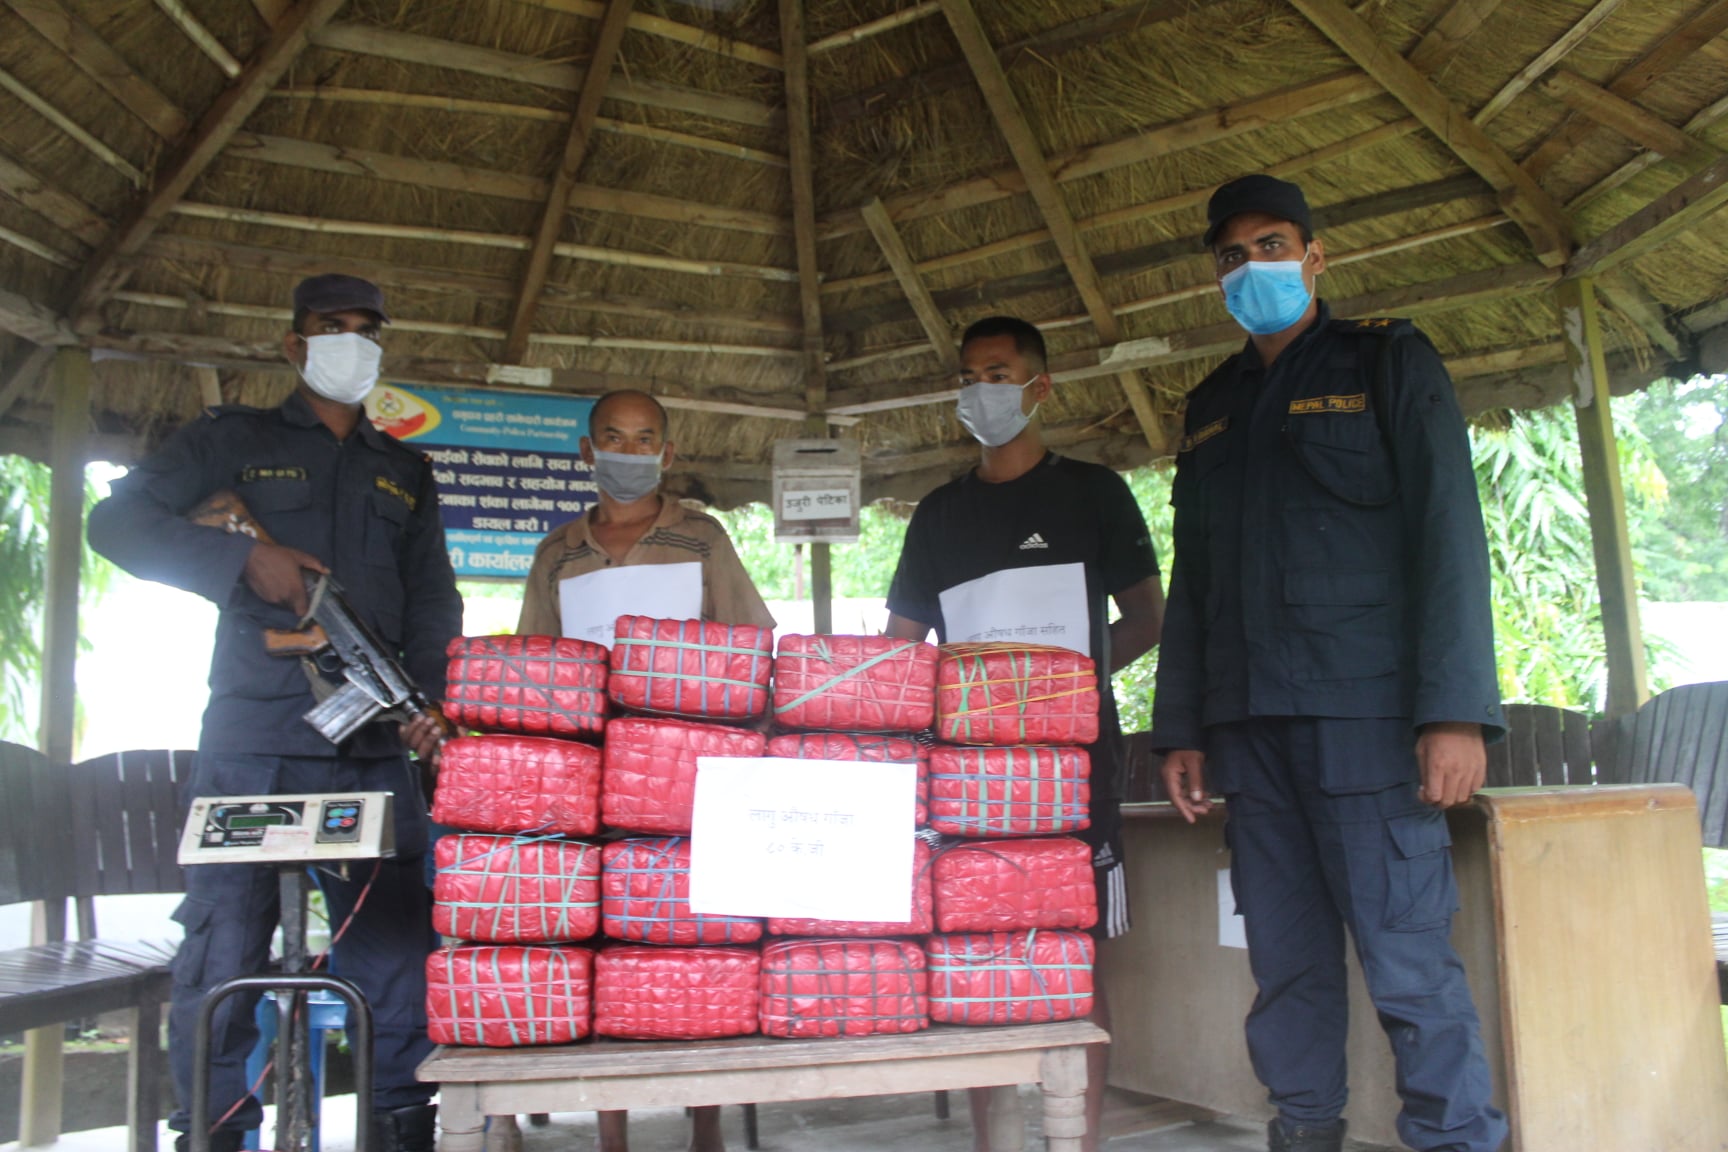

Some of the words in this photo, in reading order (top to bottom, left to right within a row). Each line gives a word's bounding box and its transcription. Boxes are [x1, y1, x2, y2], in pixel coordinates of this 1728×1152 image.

[1328, 398, 1364, 410] POLICE
[511, 454, 543, 469] लागि
[506, 477, 516, 489] र
